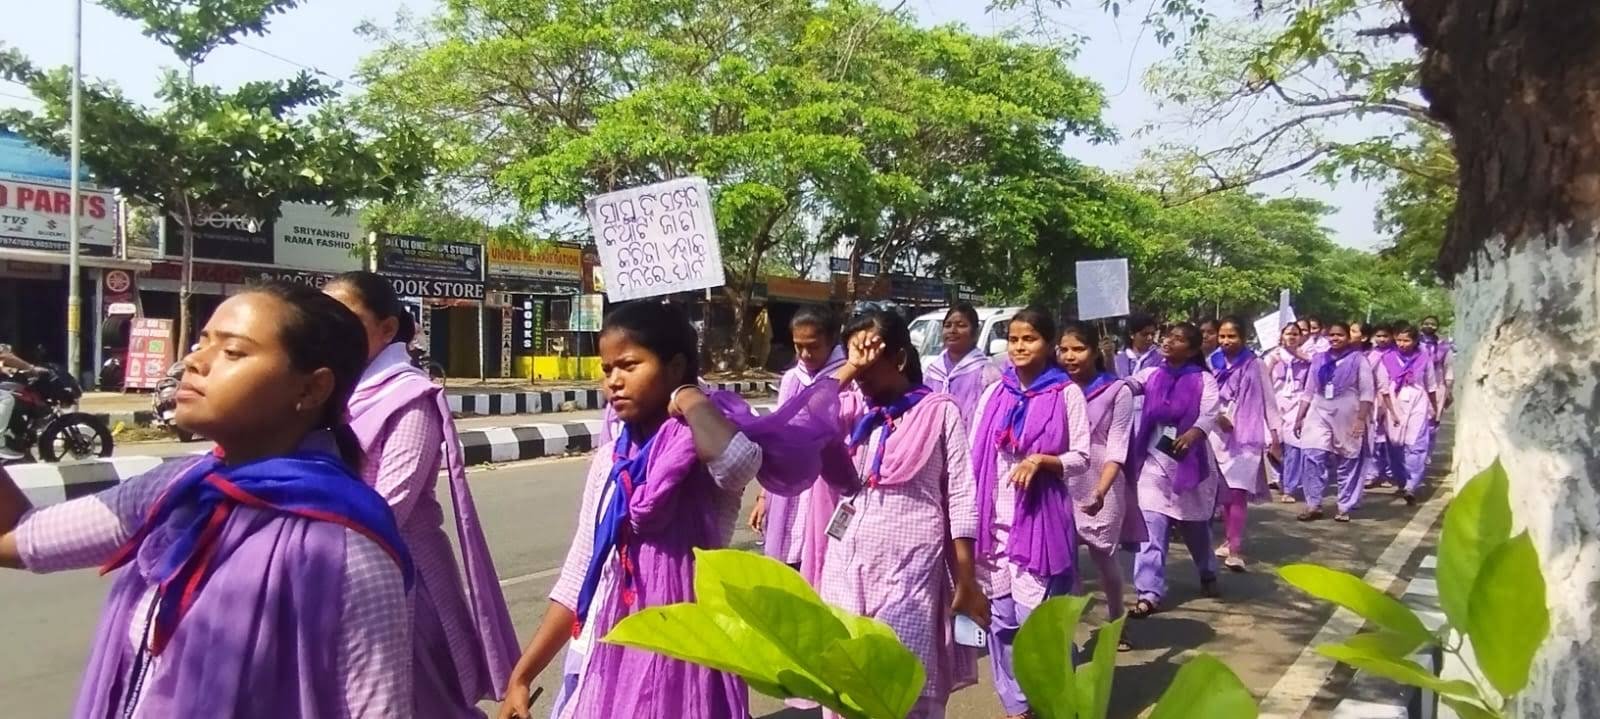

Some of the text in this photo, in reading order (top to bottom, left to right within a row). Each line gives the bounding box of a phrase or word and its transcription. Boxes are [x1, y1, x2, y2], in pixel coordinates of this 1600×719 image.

[17, 187, 106, 219] PARTS
[2, 215, 28, 225] TVS
[293, 226, 350, 240] SRIYANSHU
[284, 235, 313, 246] RAMA
[449, 245, 474, 256] STORE
[491, 247, 522, 262] UNIQUE
[388, 279, 484, 298] OOK STORE
[523, 301, 532, 348] BOOKS
